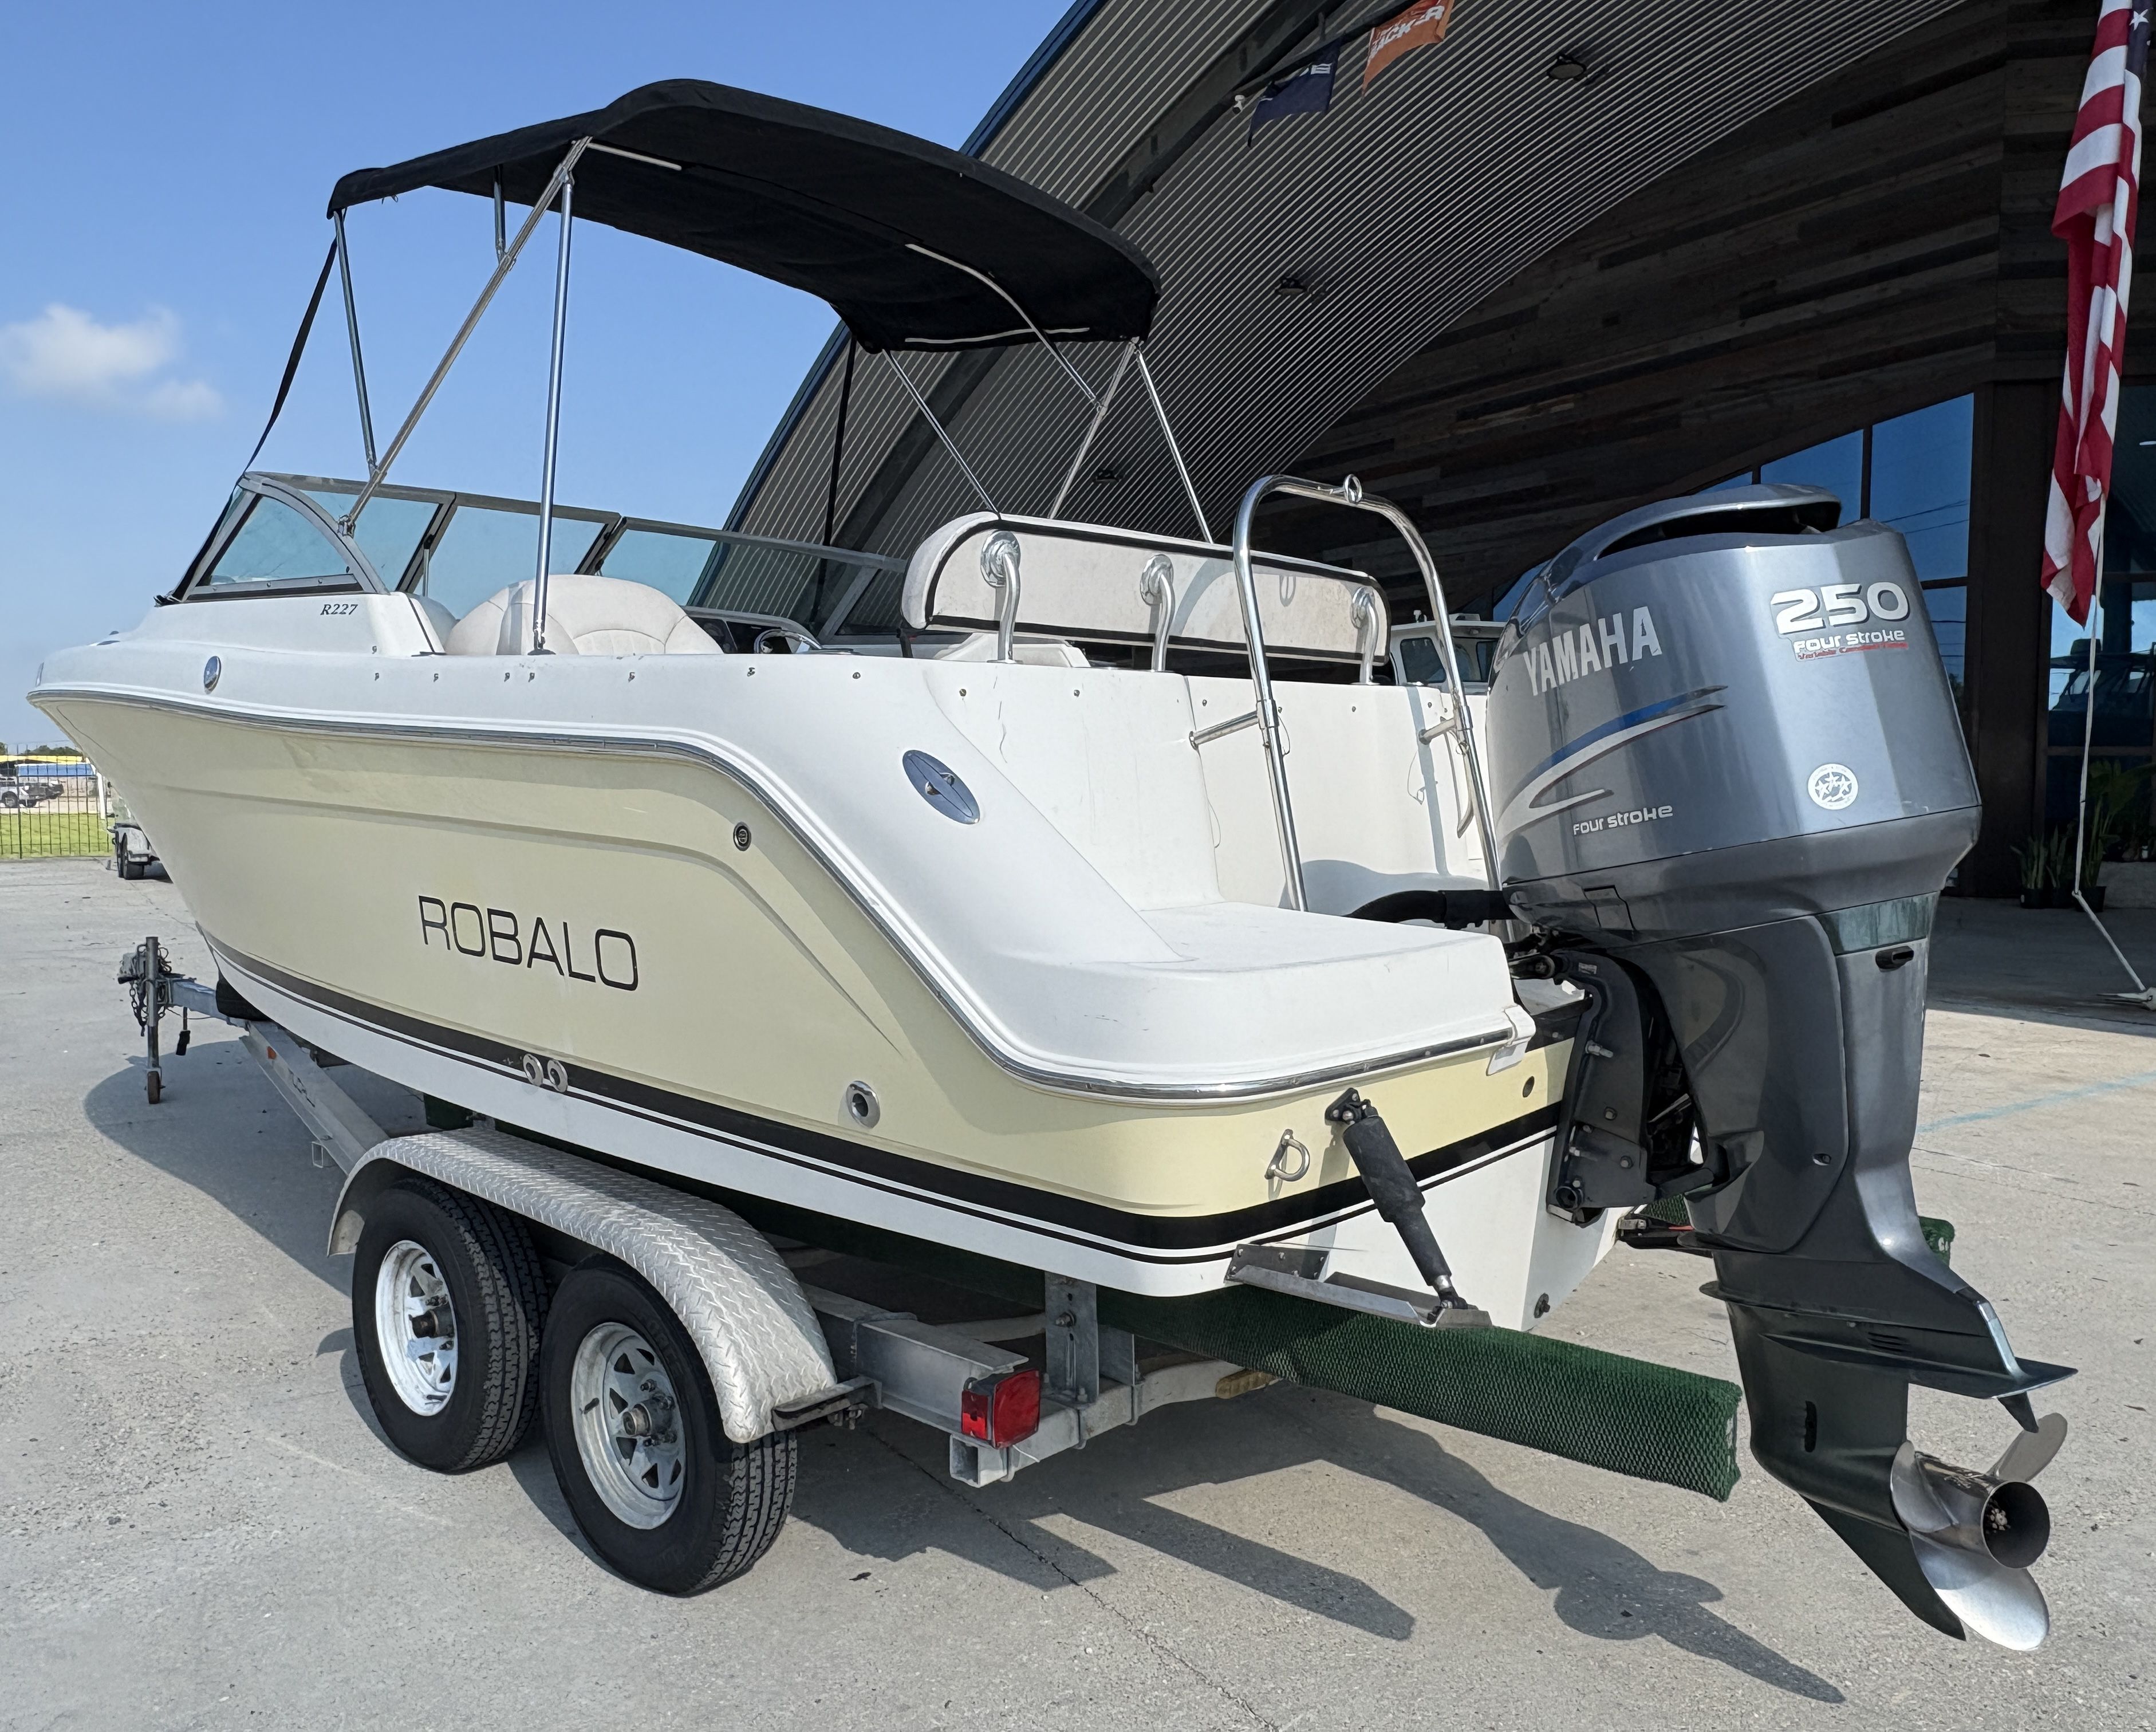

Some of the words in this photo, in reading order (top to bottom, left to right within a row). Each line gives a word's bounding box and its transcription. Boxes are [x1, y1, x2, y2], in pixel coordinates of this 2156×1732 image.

[320, 604, 358, 615] R227
[1770, 582, 1910, 635] 250
[1523, 606, 1662, 696] YAMAHA
[419, 895, 638, 991] ROBALO
